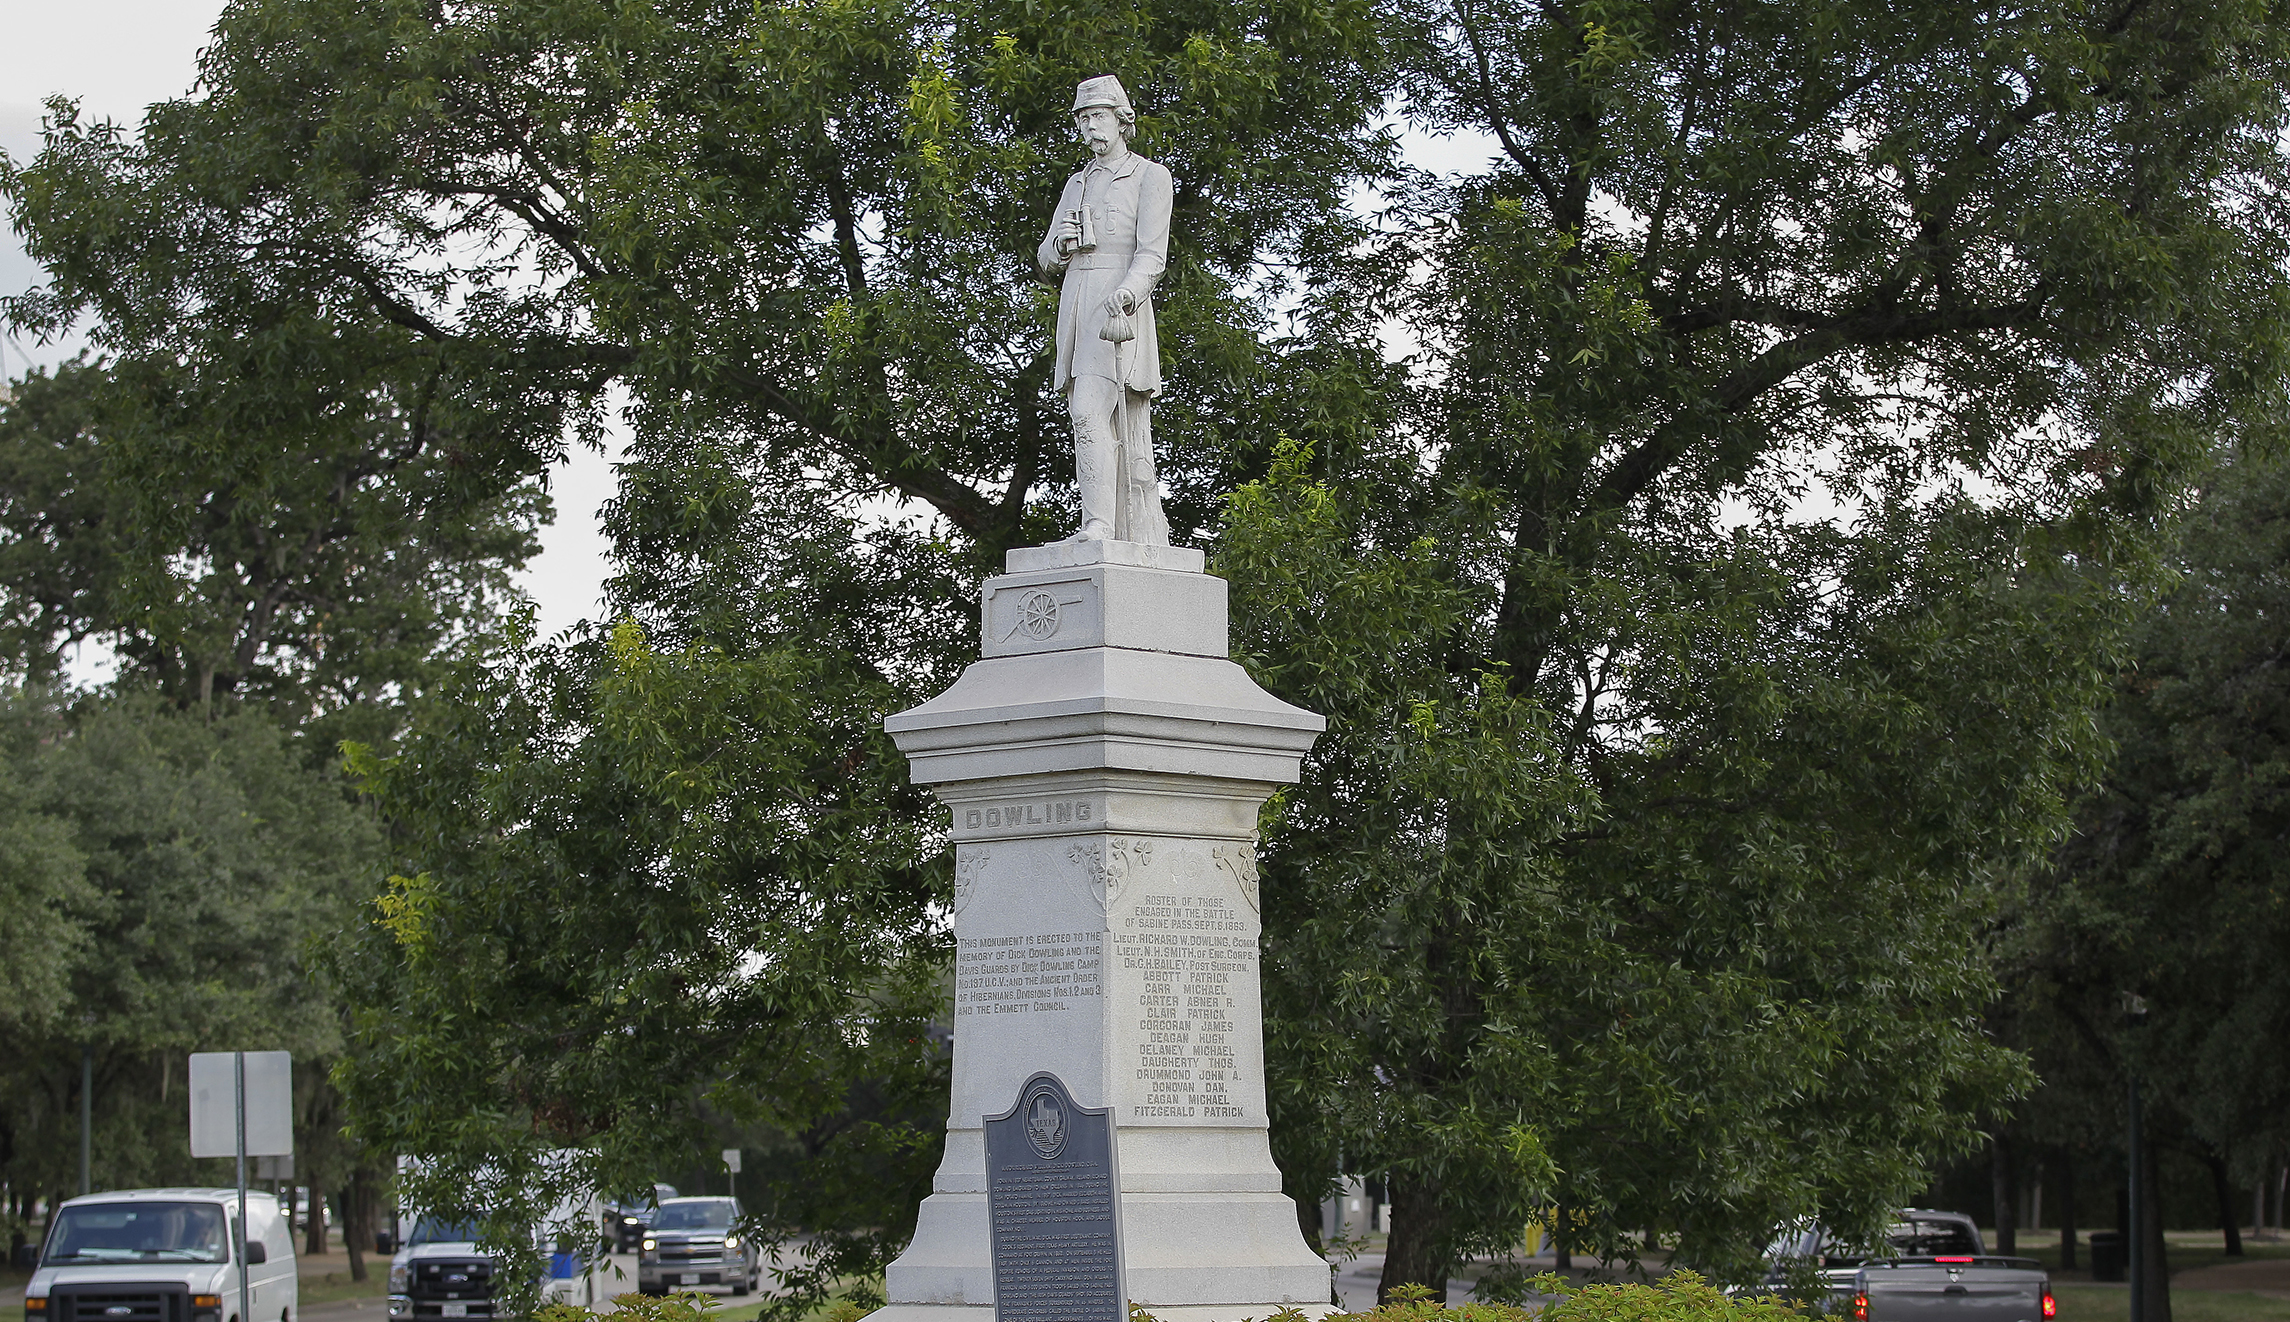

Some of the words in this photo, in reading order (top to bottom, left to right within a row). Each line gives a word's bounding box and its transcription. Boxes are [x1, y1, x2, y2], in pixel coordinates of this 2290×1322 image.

[966, 802, 1091, 829] DOWLING
[1145, 895, 1176, 906] ROSTER
[1182, 897, 1192, 906] OF
[1198, 897, 1224, 907] THOSE
[1135, 907, 1171, 917] ENGAGED
[1173, 908, 1181, 917] IN
[1185, 909, 1200, 918] THE
[1203, 909, 1234, 919] BATTLE
[1125, 918, 1135, 927] OF
[1139, 919, 1168, 929] SABINE
[959, 938, 978, 948] THIS
[980, 936, 1024, 948] MONUMENT
[1026, 936, 1034, 944] IS
[1037, 933, 1071, 944] ERECTED
[1073, 932, 1083, 942] TO
[1086, 932, 1101, 941] THE
[960, 952, 993, 962] MEMORY
[996, 951, 1005, 960] OF
[1008, 949, 1026, 959] DICK
[1029, 948, 1064, 958] DOWLING
[1066, 947, 1082, 956] AND
[1085, 946, 1100, 955] THE
[960, 965, 979, 976] DAVIS
[981, 964, 1009, 974] GUARDS
[1011, 964, 1020, 973] BY
[1022, 961, 1038, 973] DICK
[1040, 961, 1074, 971] DOWLING
[1077, 958, 1099, 969] CAMP
[1025, 976, 1038, 985] THE
[1039, 974, 1071, 985] ANCIENT
[1073, 972, 1098, 983] ORDER
[1143, 971, 1181, 982] ABBOTT
[1190, 972, 1229, 983] PATRICK
[959, 993, 968, 1002] OF
[1080, 987, 1094, 996] AND
[1095, 984, 1101, 995] 3
[1145, 983, 1171, 994] CARR
[1183, 984, 1227, 995] MICHAEL
[1139, 995, 1179, 1006] CARTER
[1187, 996, 1219, 1007] ABNER
[1226, 998, 1236, 1008] R.
[958, 1006, 973, 1015] AND
[976, 1005, 991, 1015] THE
[994, 1003, 1028, 1014] EMMETT
[1034, 1001, 1070, 1012] COUNCIL.
[1147, 1007, 1176, 1018] CLAIR
[1187, 1008, 1226, 1020] PATRICK
[1139, 1020, 1191, 1031] CORCORAN
[1201, 1021, 1234, 1032] JAMES
[1150, 1032, 1189, 1043] DEAGAN
[1199, 1033, 1224, 1044] HUGH
[1139, 1044, 1185, 1056] DELANEY
[1192, 1045, 1235, 1056] MICHAEL
[1142, 1056, 1200, 1068] DAUGHERTY
[1208, 1058, 1237, 1069] THOS.
[1136, 1068, 1191, 1080] DRUMMOND
[1199, 1070, 1224, 1080] JOHN
[1232, 1071, 1242, 1080] A.
[1152, 1082, 1195, 1093] DONOVAN
[1205, 1082, 1228, 1093] DAN.
[1147, 1094, 1179, 1105] EAGAN
[1188, 1094, 1230, 1105] MICHAEL
[1134, 1106, 1195, 1117] FITZGERALD
[1204, 1106, 1244, 1117] PATRICK
[1036, 1119, 1056, 1128] TEXAS
